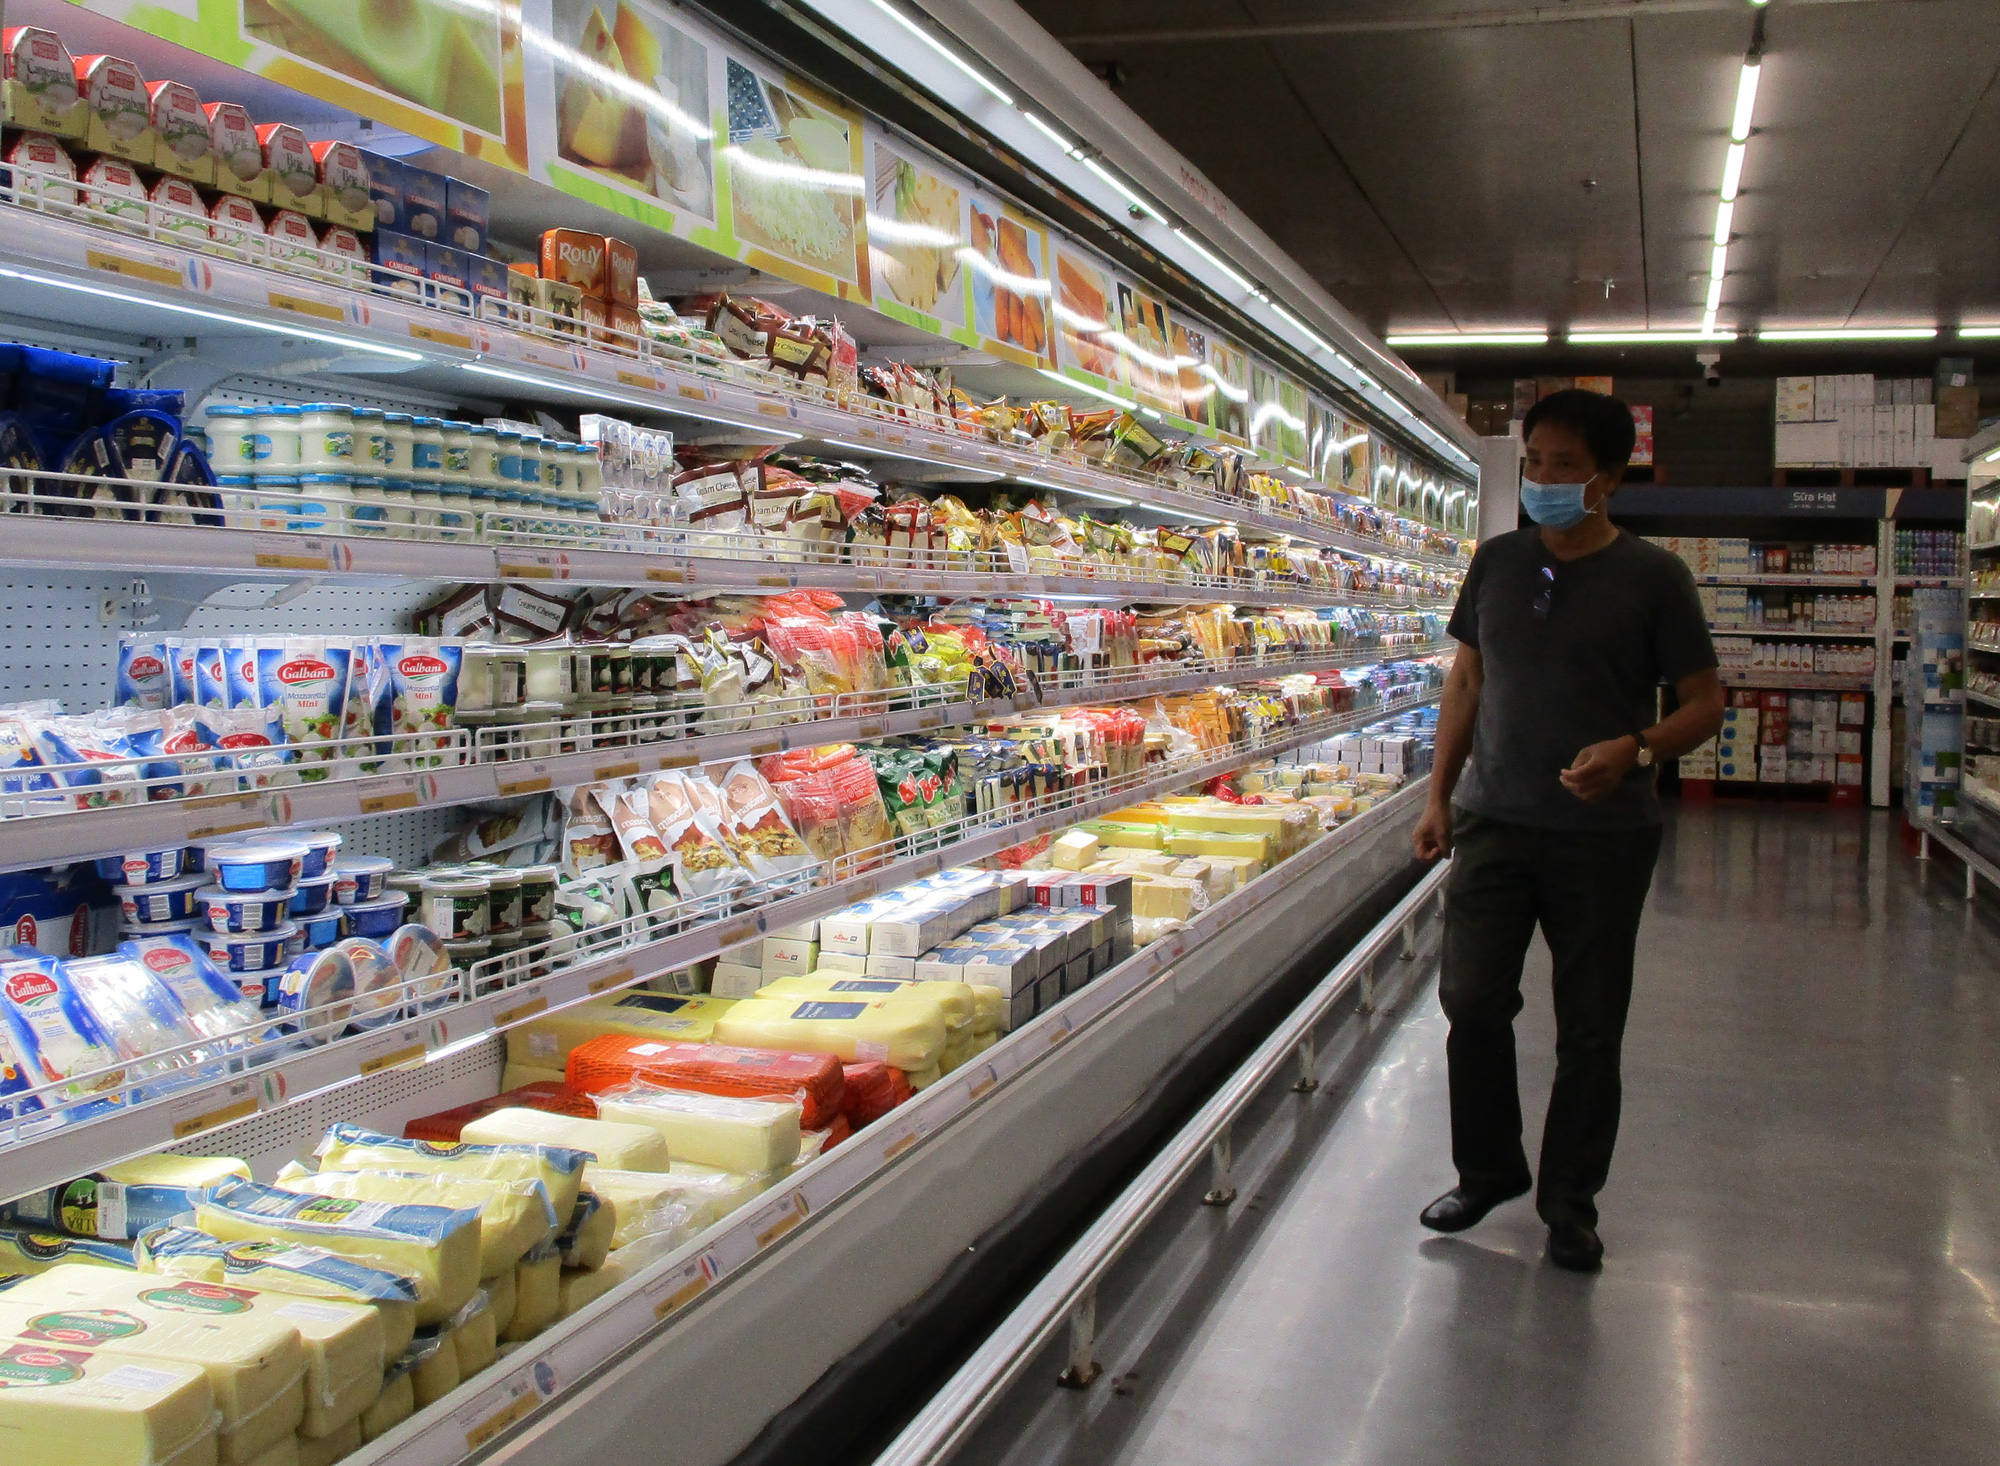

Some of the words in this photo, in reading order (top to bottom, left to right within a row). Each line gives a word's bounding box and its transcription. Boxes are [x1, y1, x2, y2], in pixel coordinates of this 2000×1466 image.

[388, 260, 420, 274] CAMEMBERT
[434, 273, 462, 285] CAMEMBERT
[517, 597, 535, 611] Cream
[535, 604, 561, 622] Cheese
[282, 666, 330, 680] Galbani
[401, 661, 442, 675] Galbani
[287, 692, 328, 700] Mozzarella
[414, 692, 433, 700] Mini
[10, 979, 53, 999] Galbani
